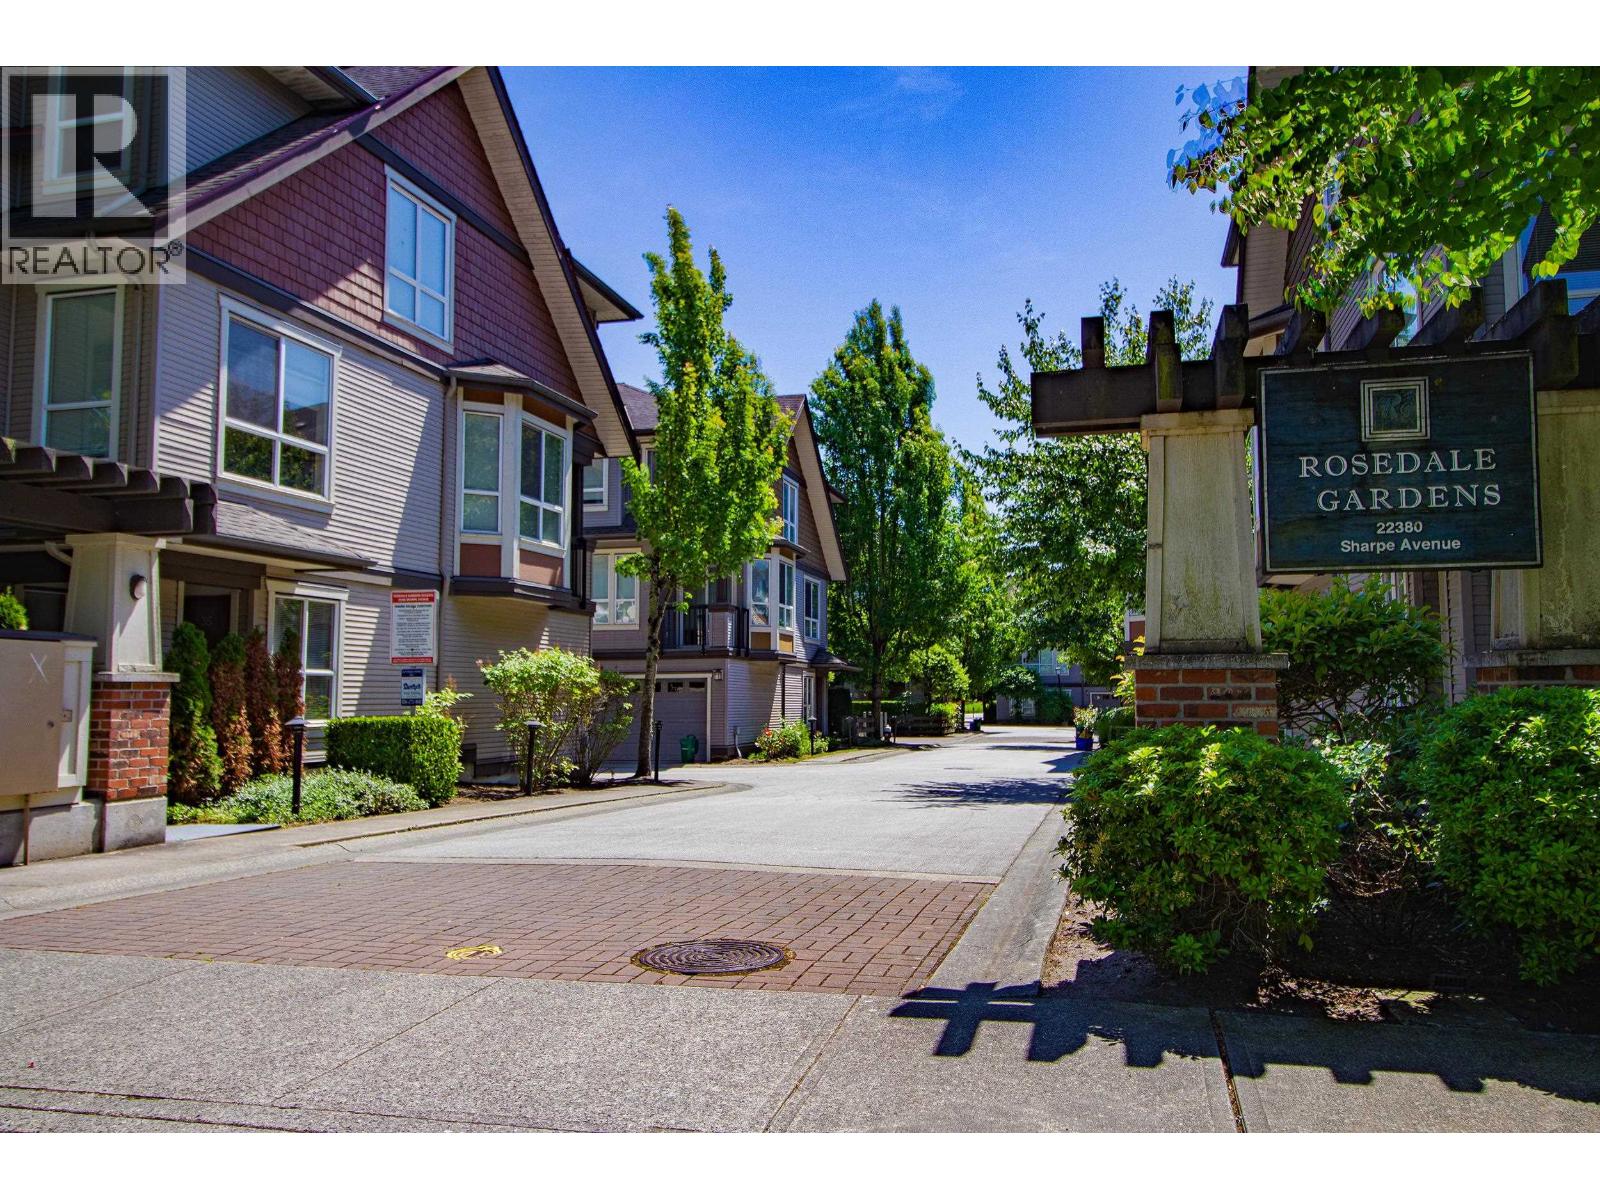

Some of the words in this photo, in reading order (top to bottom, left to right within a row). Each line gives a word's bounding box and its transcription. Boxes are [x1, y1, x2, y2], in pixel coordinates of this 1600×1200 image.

[1298, 448, 1497, 478] ROSEDALE
[1316, 484, 1501, 511] GARDENS
[1376, 521, 1423, 535] 22380
[1340, 539, 1395, 554] Sharpe
[1400, 537, 1461, 552] Avenue
